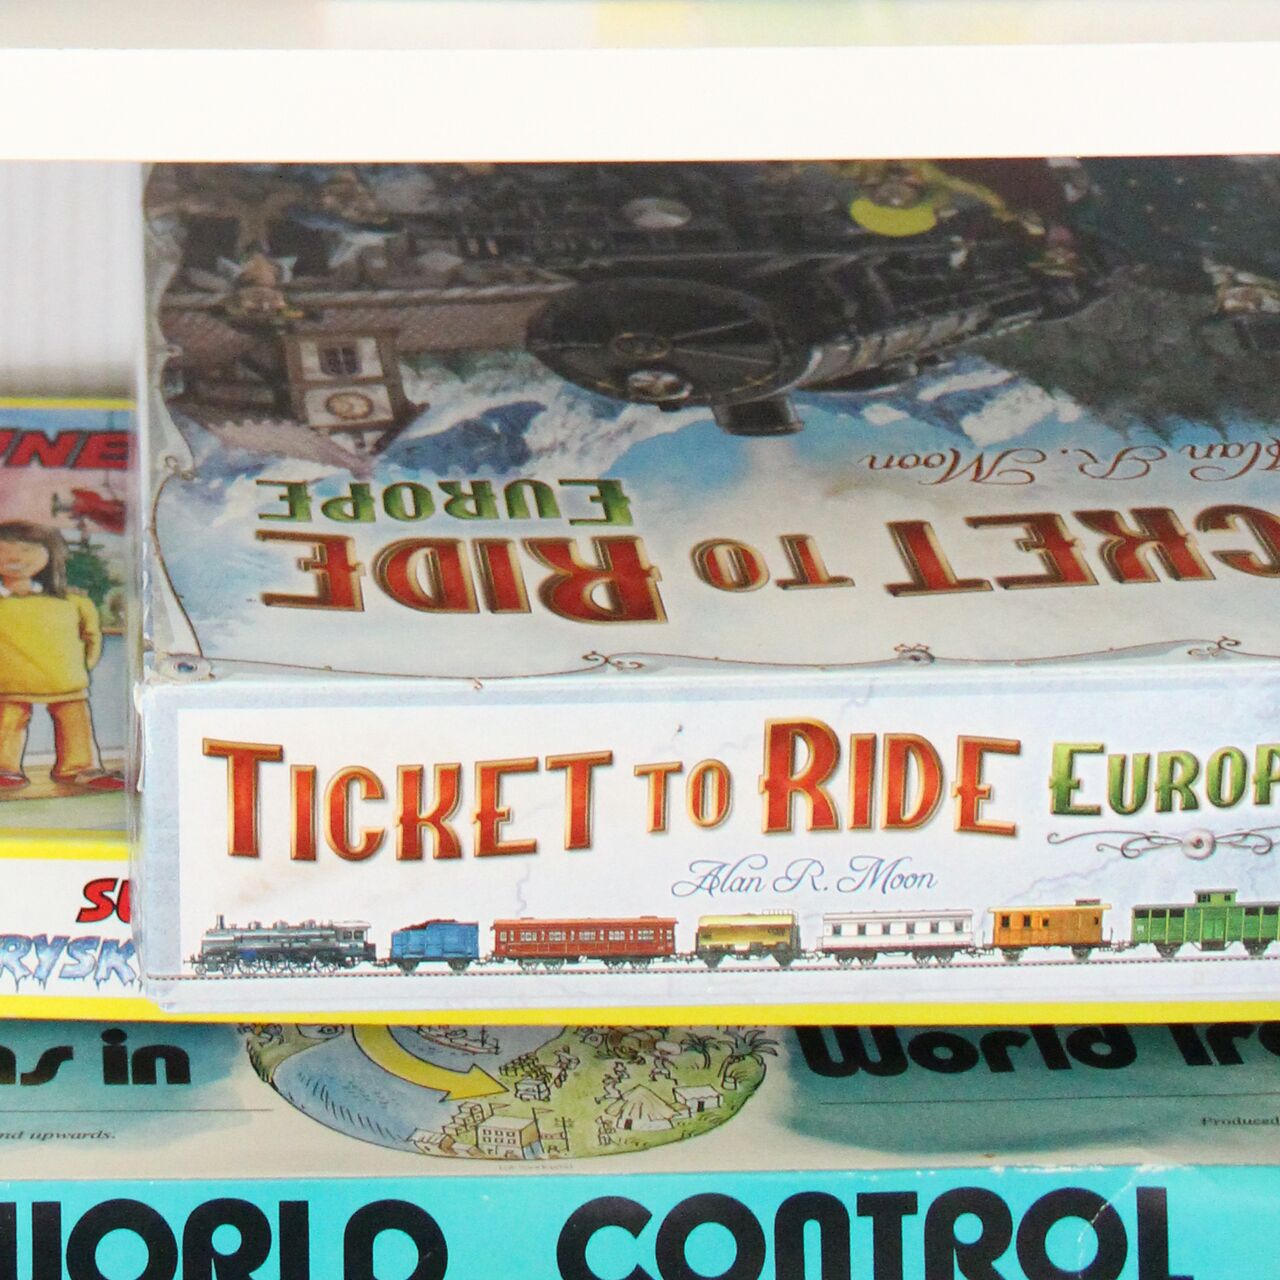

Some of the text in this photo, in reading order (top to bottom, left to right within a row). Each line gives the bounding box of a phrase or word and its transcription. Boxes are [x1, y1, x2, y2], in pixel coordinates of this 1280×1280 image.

[255, 479, 635, 527] EUROPE
[255, 529, 670, 626] RIDE
[690, 532, 856, 594] TO
[202, 736, 615, 864] TICKET
[633, 757, 734, 834] TO
[757, 715, 1022, 839] RIDE
[671, 854, 939, 898] Alan R. Moon
[101, 1026, 191, 1086] in
[29, 1128, 117, 1143] upwards.
[1201, 1114, 1280, 1128] Produced
[557, 1186, 1194, 1280] CONTROL
